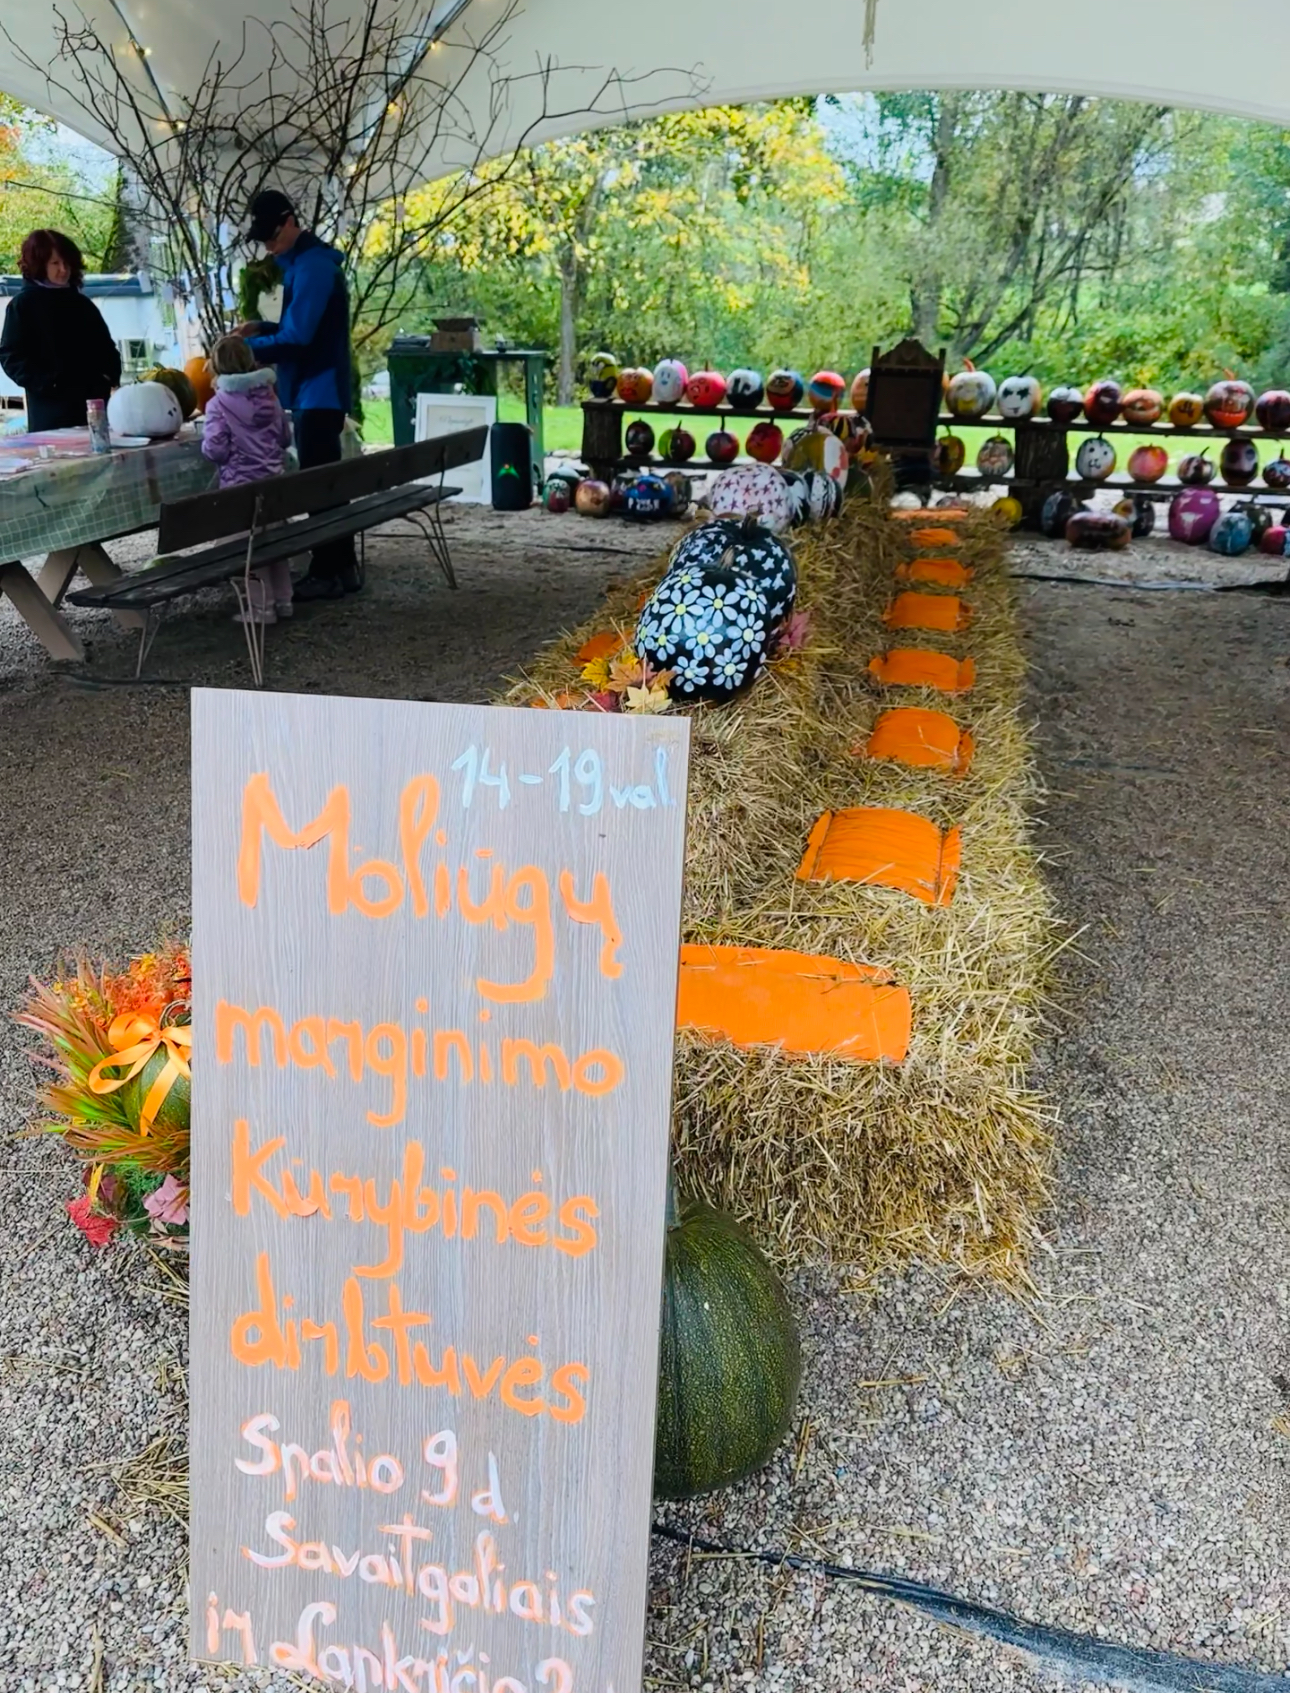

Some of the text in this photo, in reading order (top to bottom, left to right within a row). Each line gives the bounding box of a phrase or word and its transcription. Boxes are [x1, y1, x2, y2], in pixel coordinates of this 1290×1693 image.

[451, 744, 604, 816] 14-19
[237, 772, 623, 1003] Moliūgų
[215, 998, 625, 1128] marginimo
[230, 1251, 591, 1424] dirbtuvės
[234, 1399, 405, 1502] Spalio
[421, 1429, 459, 1506] 9
[206, 1590, 258, 1666] ir
[240, 1510, 596, 1636] Savaitgaliais
